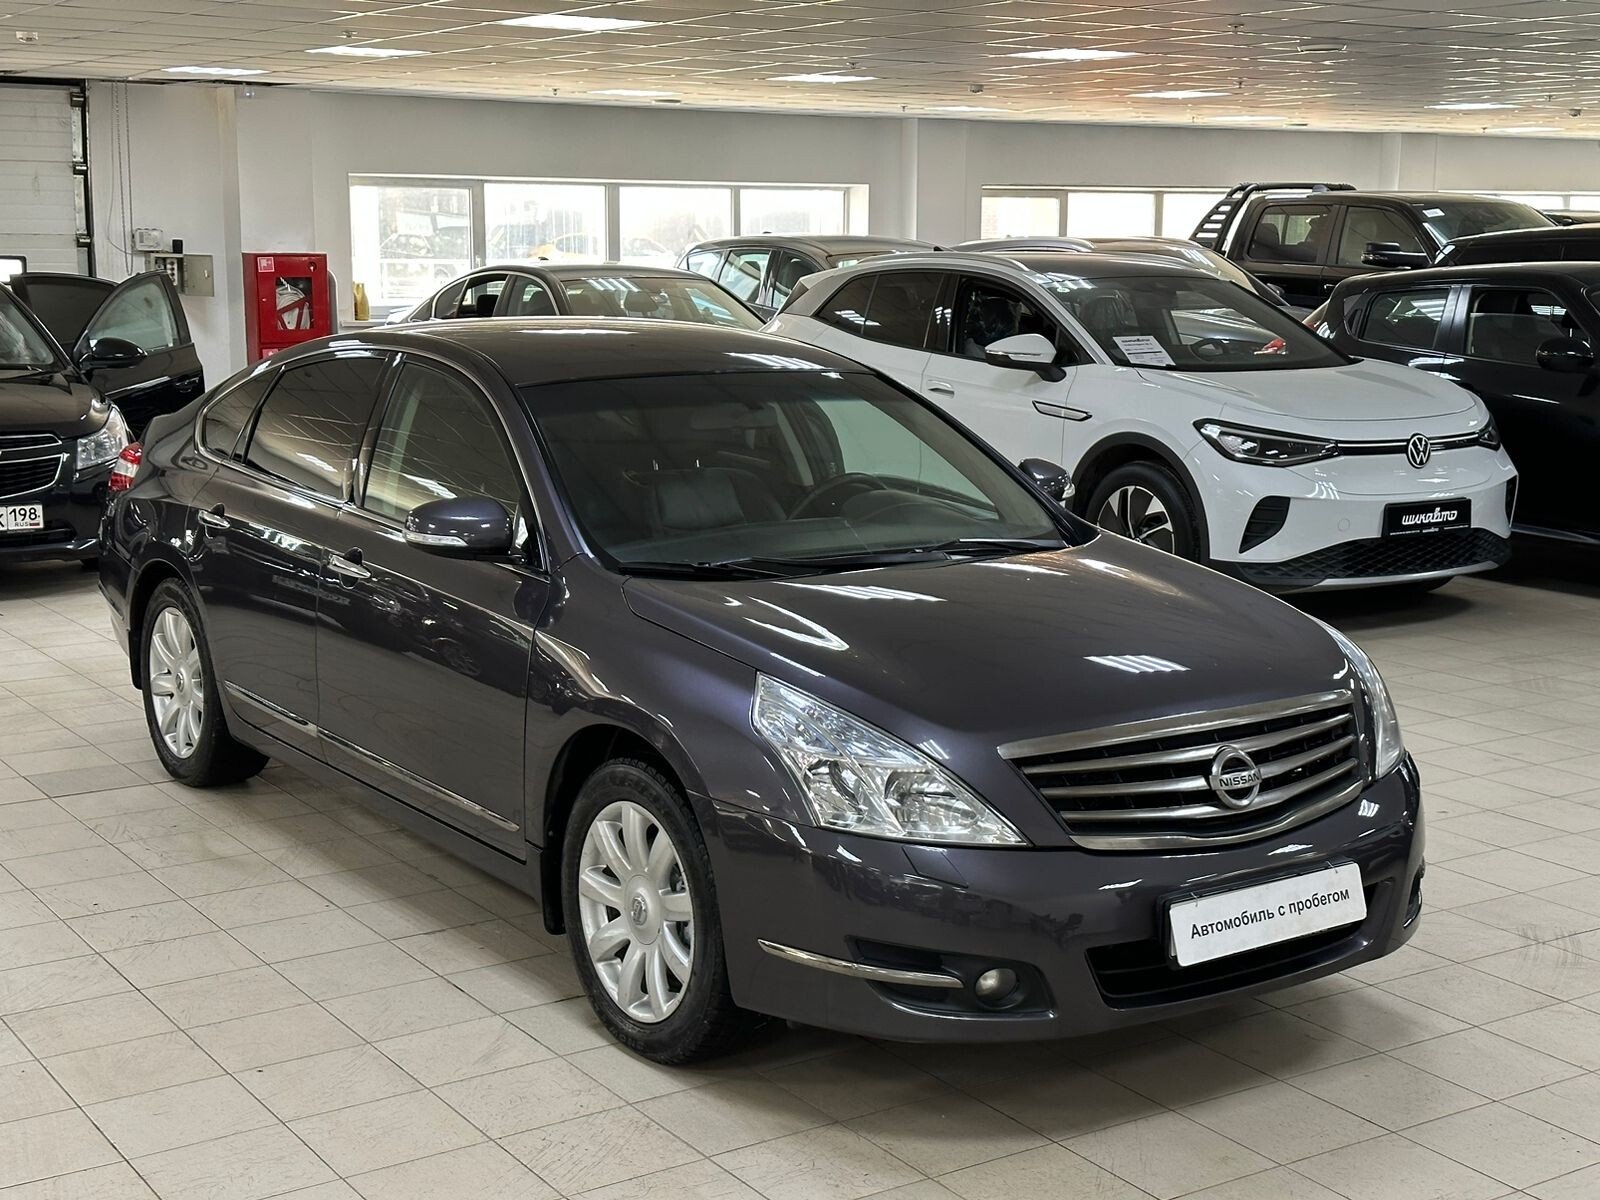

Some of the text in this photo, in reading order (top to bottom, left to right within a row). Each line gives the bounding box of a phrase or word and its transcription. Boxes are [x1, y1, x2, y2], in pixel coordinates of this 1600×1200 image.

[9, 507, 37, 521] 198
[1219, 773, 1260, 787] NISSAN
[1191, 888, 1350, 939] Автомобиль с пробегом
